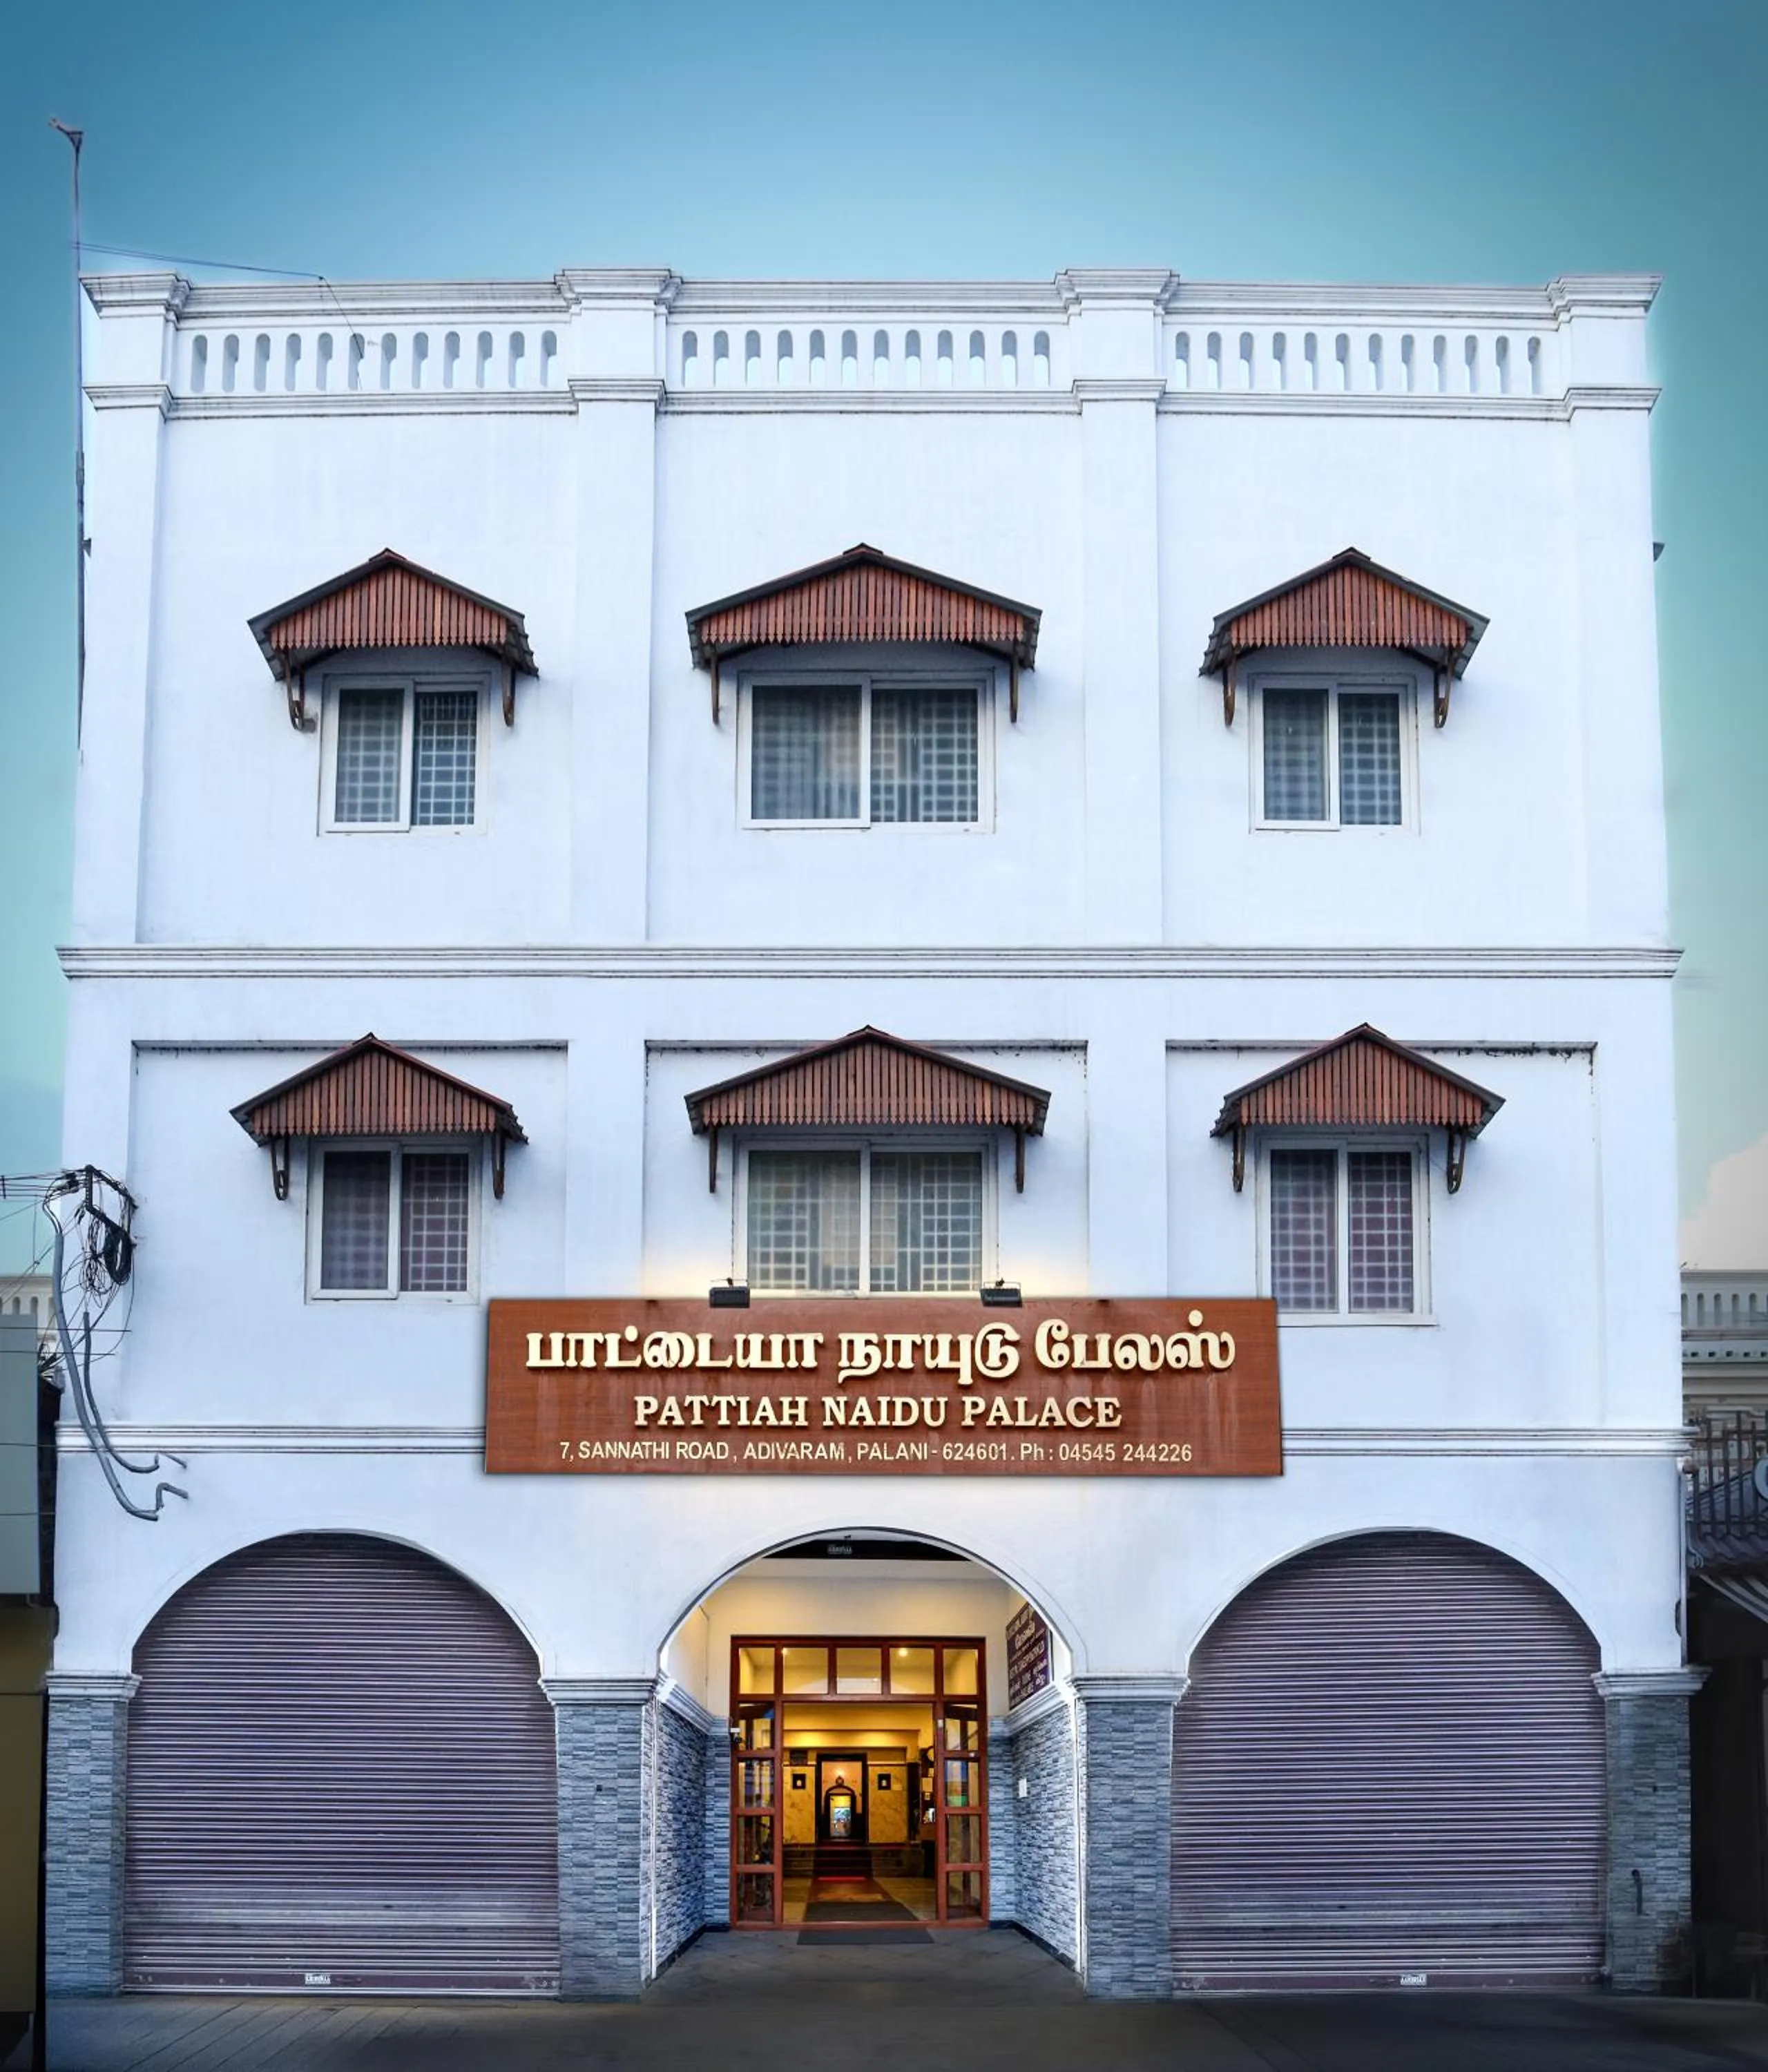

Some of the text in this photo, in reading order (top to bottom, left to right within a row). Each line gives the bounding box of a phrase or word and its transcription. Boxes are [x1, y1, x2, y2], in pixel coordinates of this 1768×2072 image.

[526, 1310, 1236, 1385] பாட்டையா நாயுடு பேலஸ்
[634, 1395, 1122, 1428] PATTIAH NAIDU PALACE
[560, 1441, 574, 1462] 7,
[578, 1441, 669, 1459] SANNATHI
[1059, 1443, 1116, 1462] 04545
[1123, 1443, 1193, 1462] 244226
